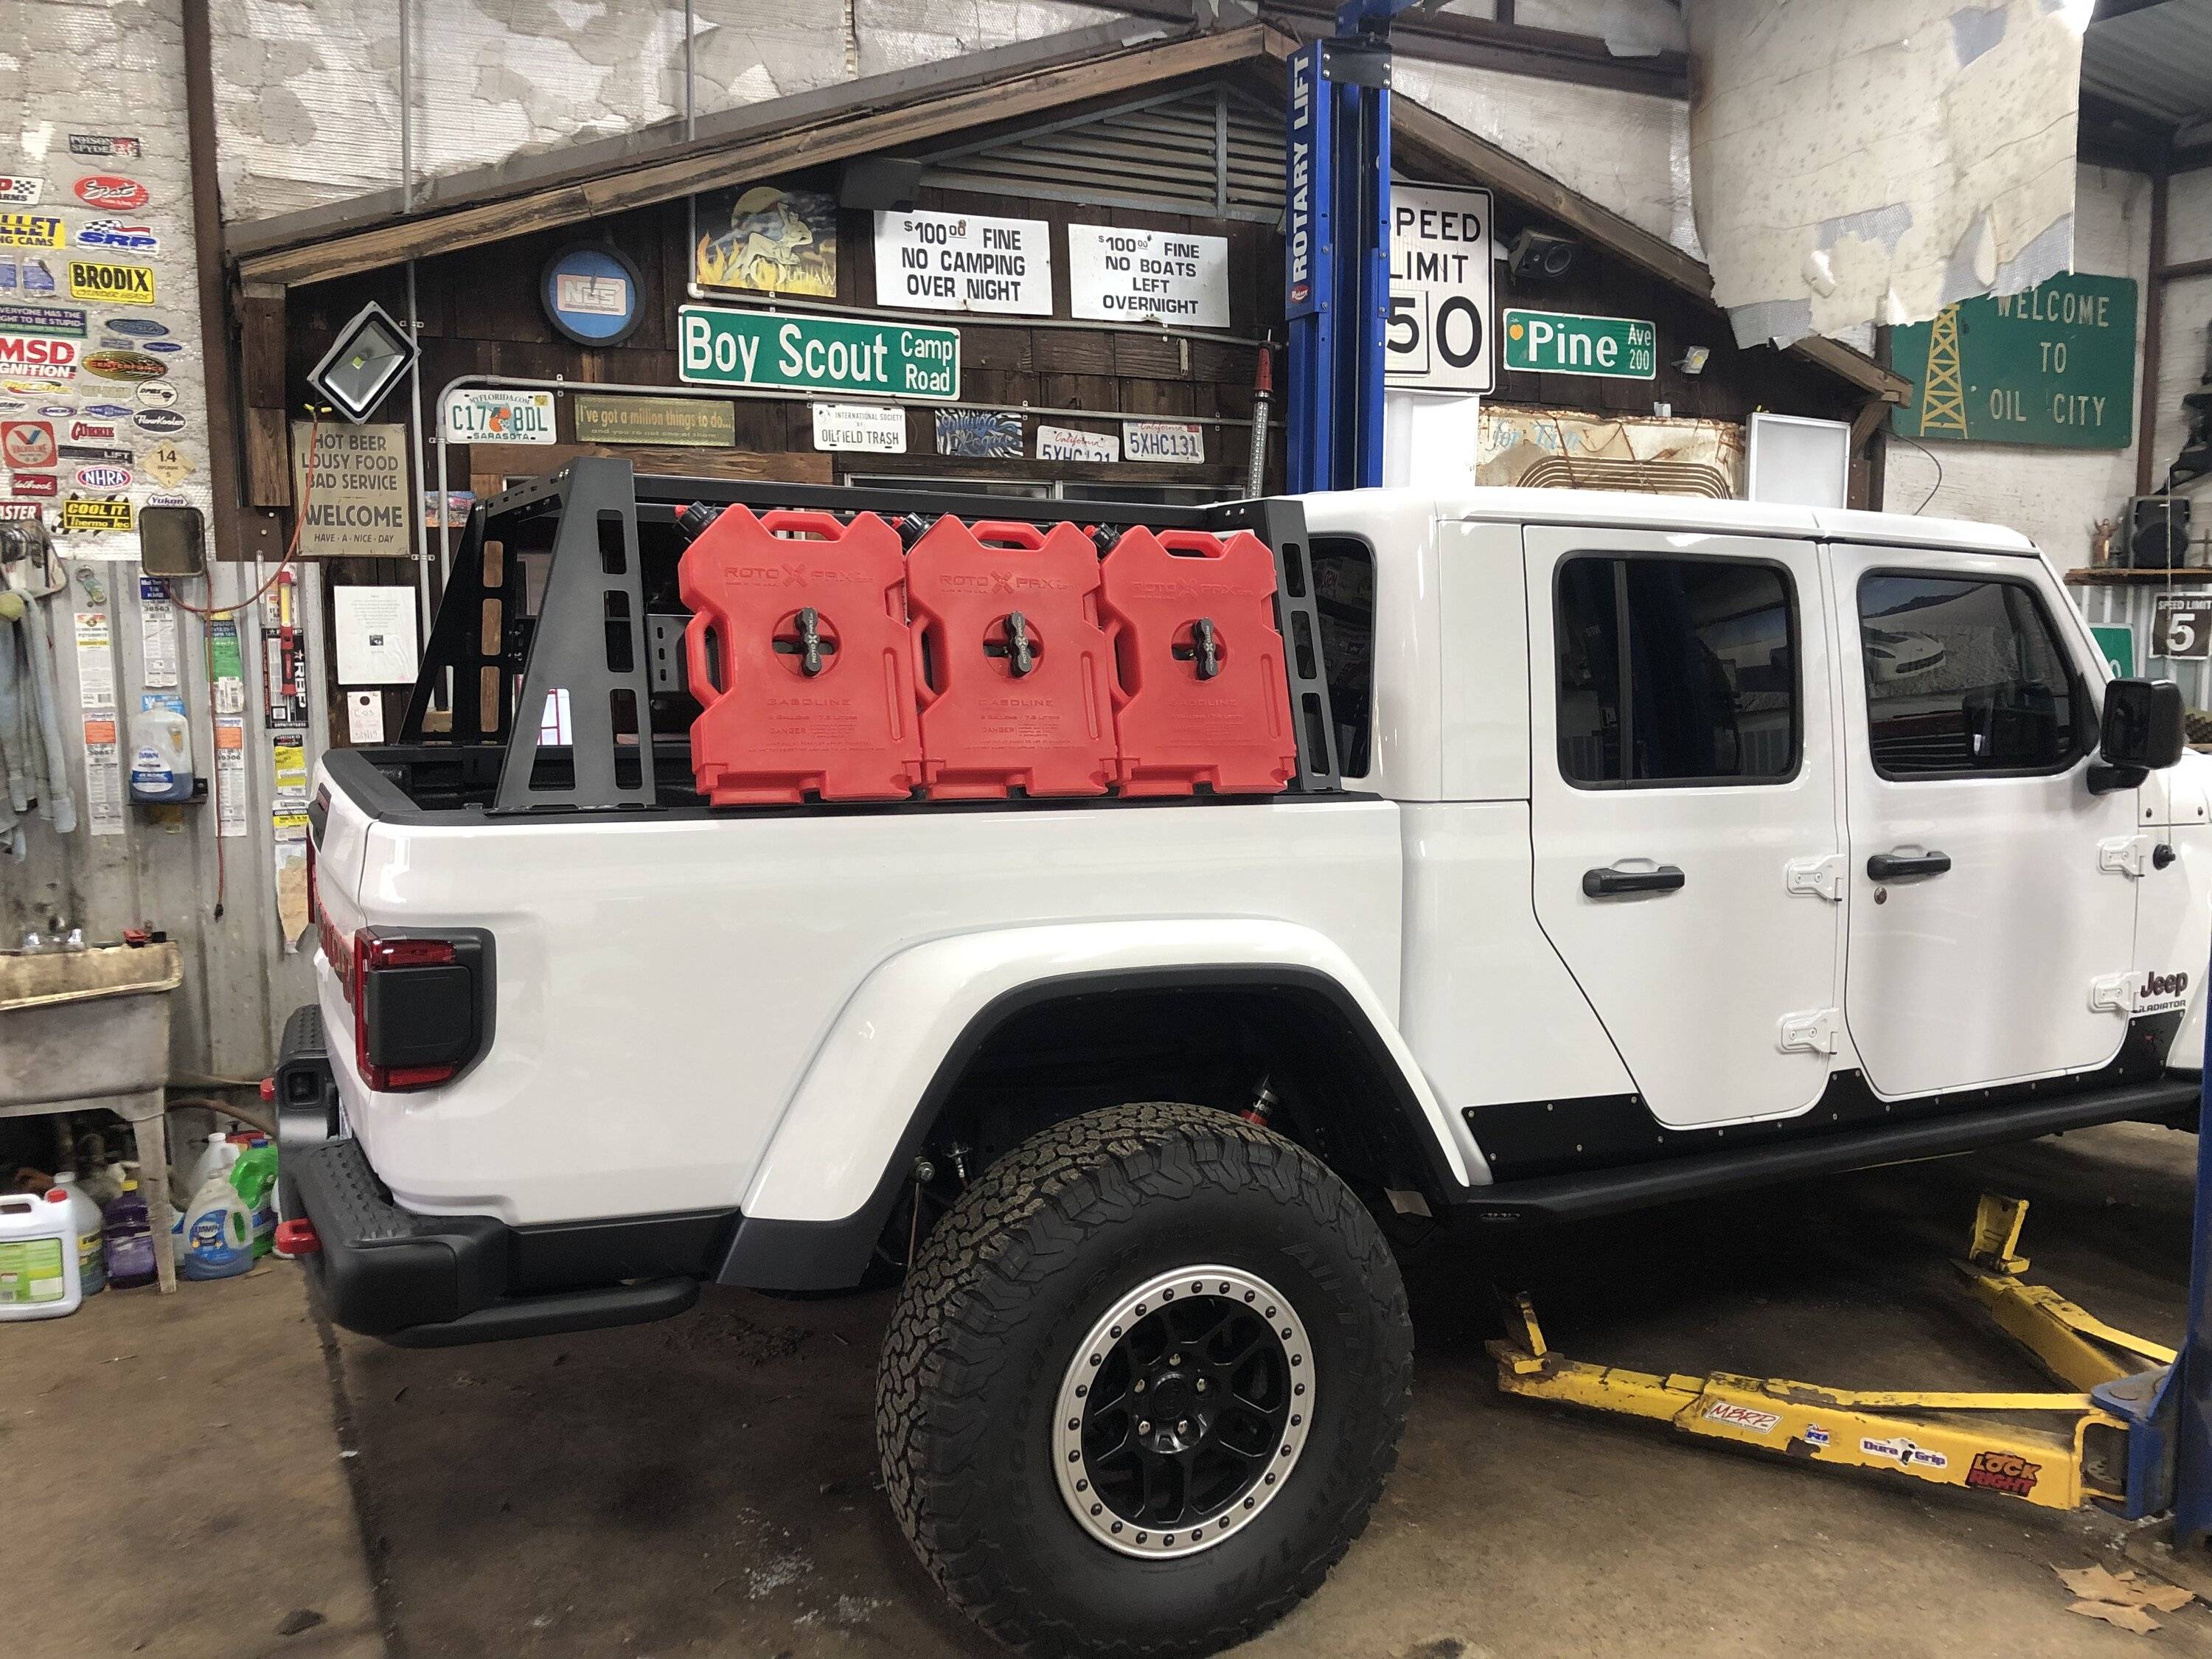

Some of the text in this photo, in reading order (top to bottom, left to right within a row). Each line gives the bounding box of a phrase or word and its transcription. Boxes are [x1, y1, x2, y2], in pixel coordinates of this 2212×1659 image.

[1292, 56, 1310, 283] ROTARY LIFT
[1390, 206, 1481, 243] PEED
[18, 237, 54, 247] CAMS
[78, 232, 156, 247] SRP
[983, 228, 1022, 251] FINE
[1164, 242, 1200, 260] FINE
[902, 247, 1026, 276] NO CAMPING
[1105, 255, 1197, 278] NO BOATS
[72, 264, 151, 293] BRODIX
[907, 274, 1022, 302] OVER NIGHT
[1133, 276, 1170, 294] LEFT
[44, 310, 62, 318] HAS
[64, 311, 82, 319] THE
[1102, 294, 1199, 315] OVERNIGHT
[1997, 285, 2110, 327] WELCOME
[1386, 296, 1483, 369] 50
[1528, 320, 1618, 368] Pine
[1628, 323, 1652, 347] Ave
[0, 337, 75, 365] MSD
[686, 316, 888, 383] Boy Scout
[900, 330, 953, 366] Camp
[2040, 341, 2067, 373] TO
[1630, 349, 1650, 371] 200
[905, 363, 950, 392] Road
[601, 409, 618, 428] got
[620, 413, 627, 424] a
[630, 408, 664, 425] million
[666, 411, 696, 431] things
[698, 415, 709, 428] to
[835, 411, 877, 420] INTERNATIONAL
[1991, 389, 2106, 427] OIL CITY
[316, 434, 387, 451] HOT BEER
[473, 432, 530, 440] SARASOTA
[821, 429, 899, 445] OILFIELD TRASH
[1130, 431, 1200, 457] 5XHC131
[302, 452, 398, 471] LOUSY FOOD
[84, 471, 124, 486] NHRA
[342, 473, 397, 491] SERVICE
[68, 503, 126, 515] COOL IT
[305, 504, 403, 528] WELCOME
[314, 533, 335, 542] HAVE
[353, 534, 372, 543] NICE
[378, 534, 394, 543] DAY
[2158, 600, 2211, 611] SPEED LIMIT
[2167, 613, 2195, 651] 5
[2140, 971, 2188, 998] Jeep
[1710, 1405, 1776, 1427] MBRP
[1863, 1441, 1946, 1466] Dura Grip
[1973, 1453, 2042, 1478] LOCK
